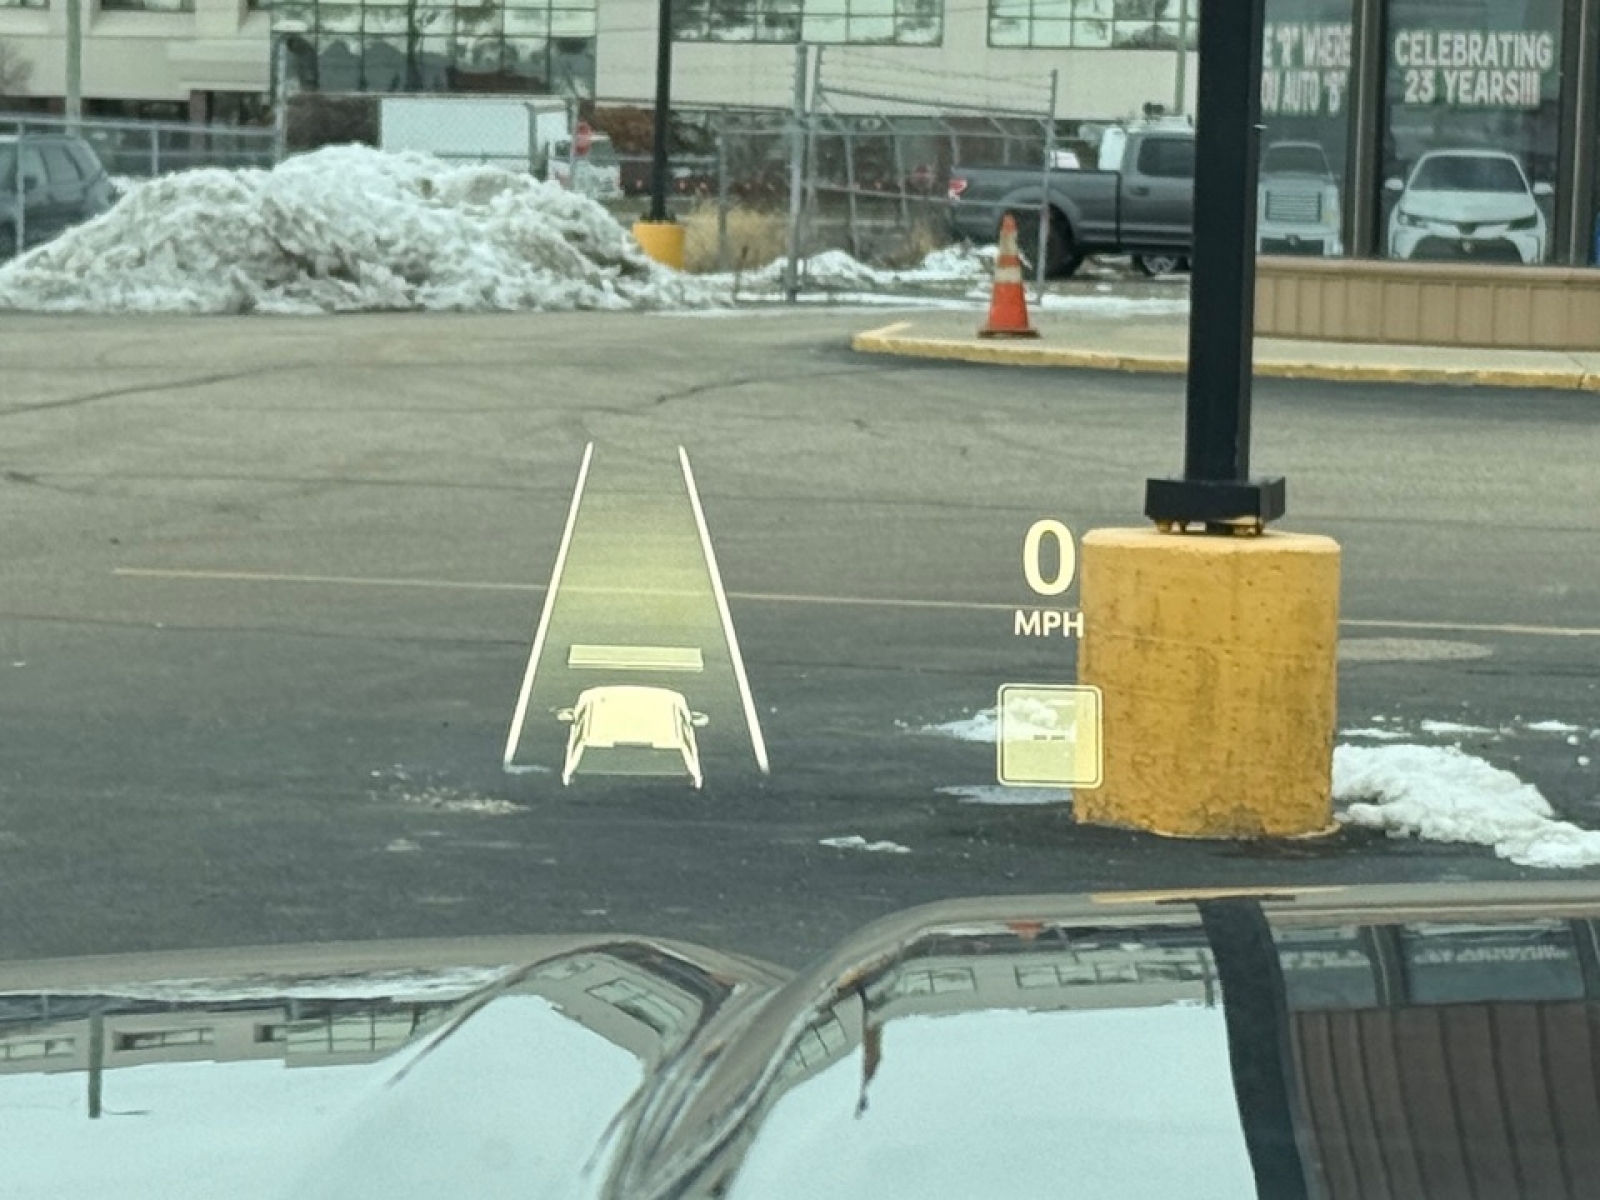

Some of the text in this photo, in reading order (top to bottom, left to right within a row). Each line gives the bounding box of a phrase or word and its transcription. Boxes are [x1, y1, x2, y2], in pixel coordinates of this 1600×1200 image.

[1395, 30, 1553, 70] CELEBRATING
[1404, 69, 1541, 106] 23 YEARS!!!
[1023, 519, 1076, 596] 0
[1014, 609, 1084, 638] MPH
